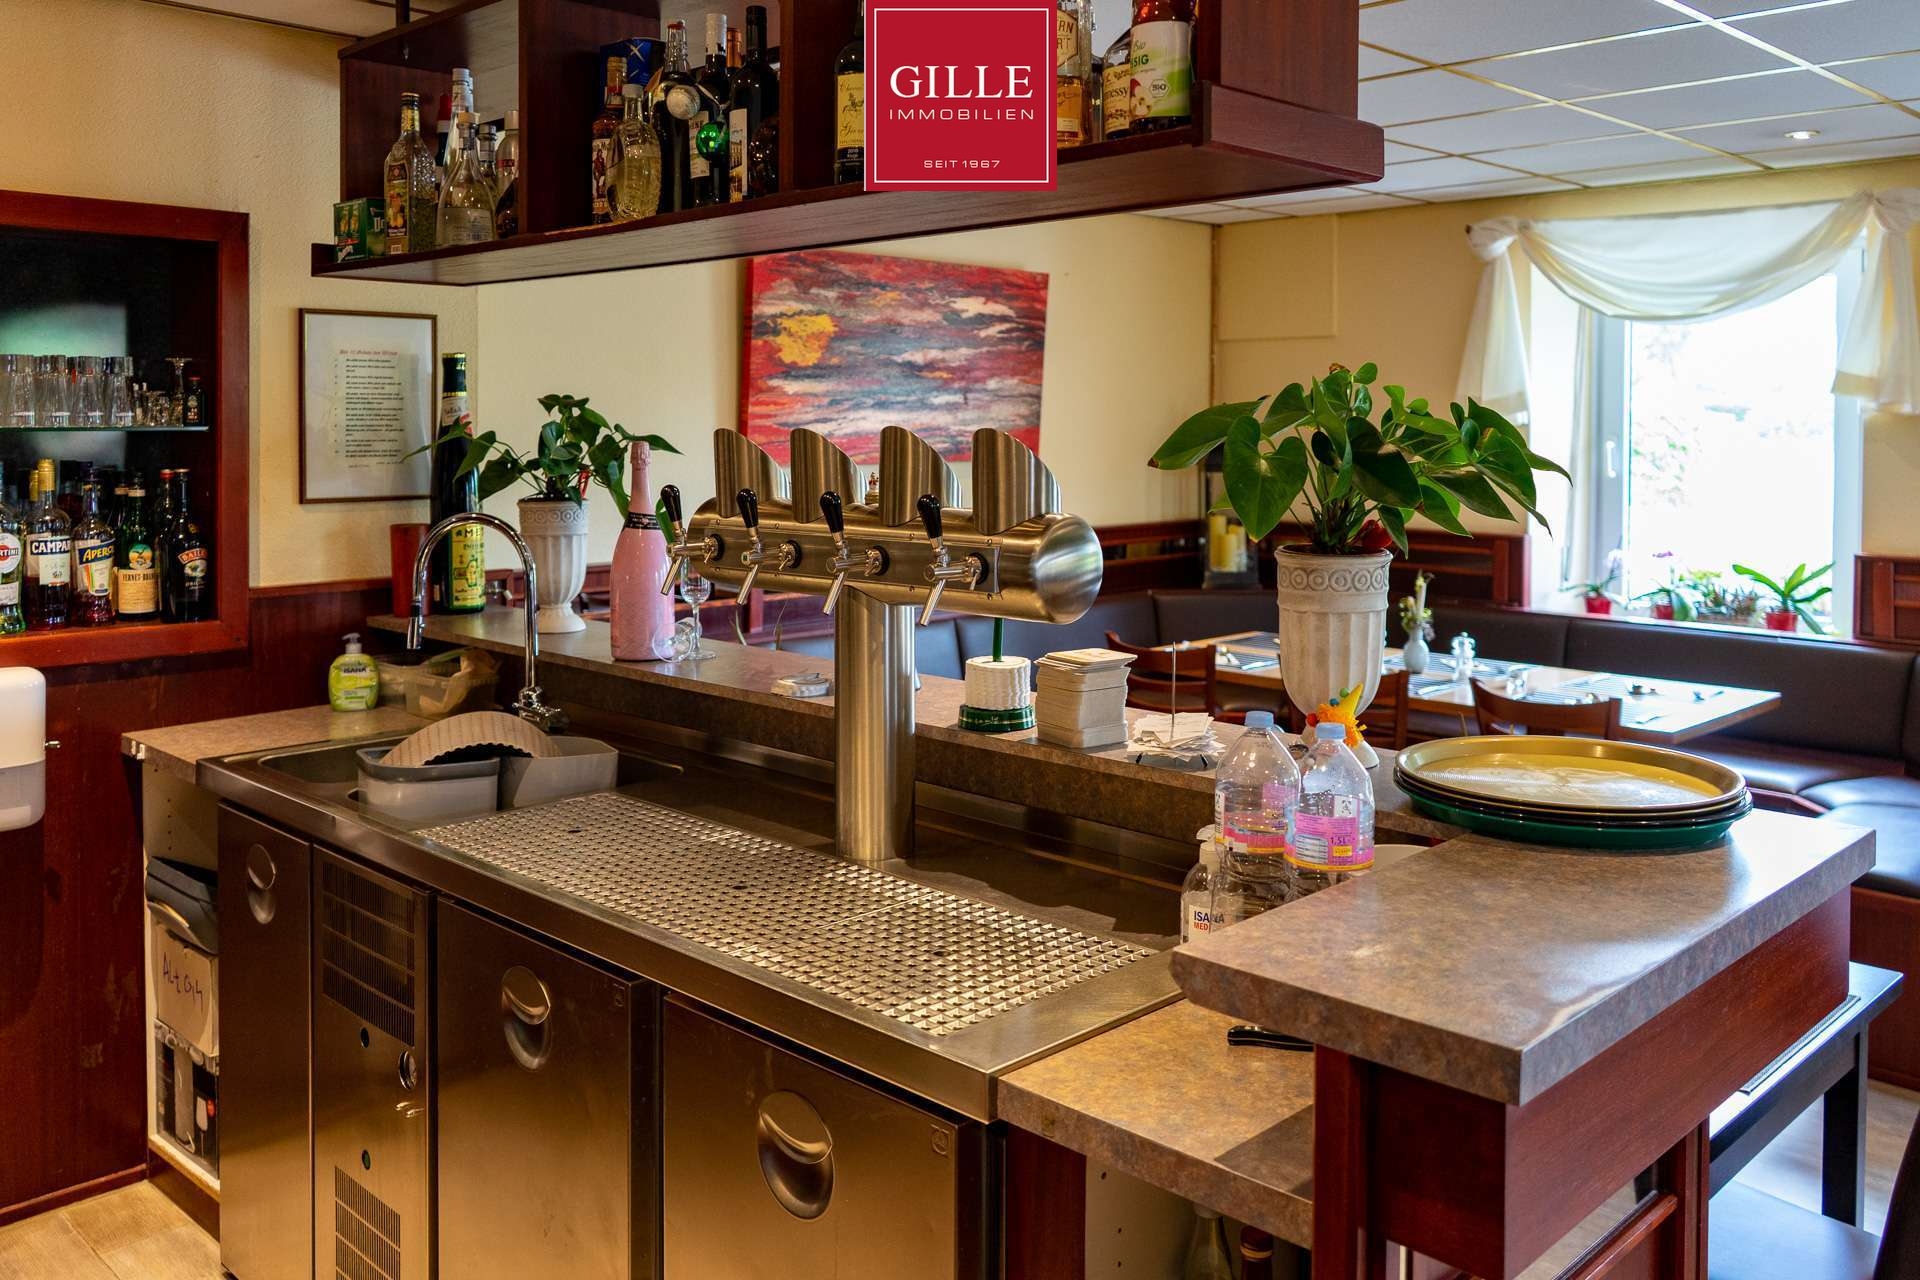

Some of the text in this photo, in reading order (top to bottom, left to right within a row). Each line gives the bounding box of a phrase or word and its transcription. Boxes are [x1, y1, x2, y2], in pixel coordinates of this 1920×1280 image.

[1130, 54, 1150, 69] SIG
[1152, 83, 1167, 92] BIO
[0, 548, 18, 557] RTINI
[32, 541, 70, 554] CAMPA
[83, 545, 113, 562] APERO
